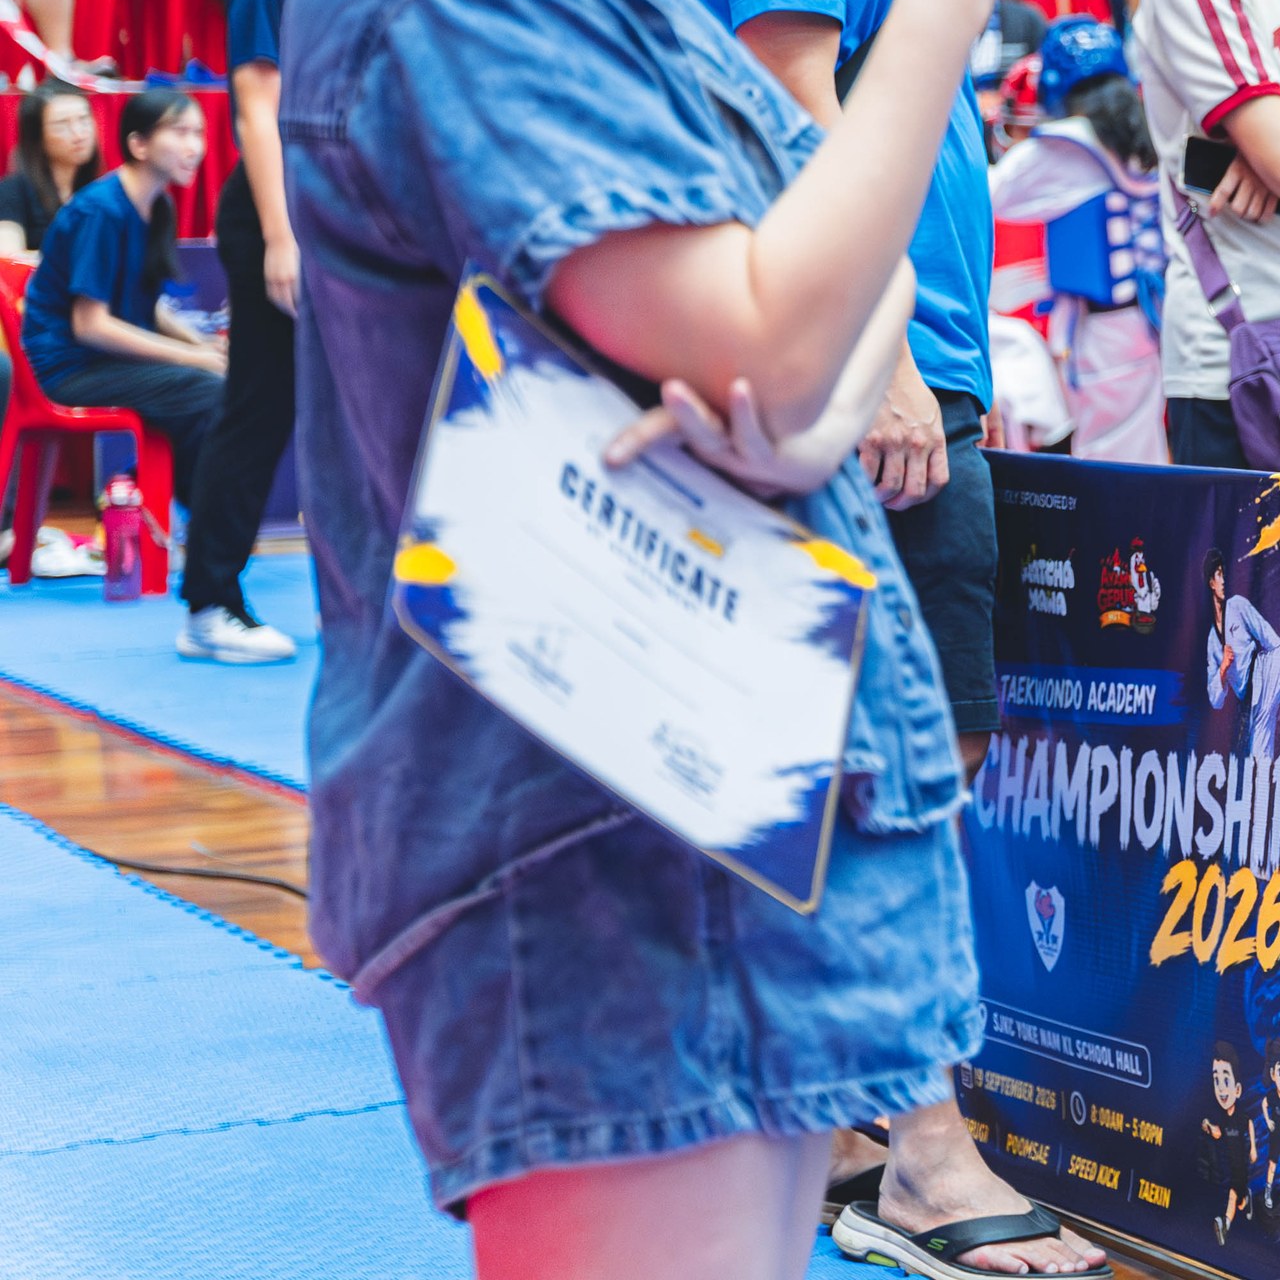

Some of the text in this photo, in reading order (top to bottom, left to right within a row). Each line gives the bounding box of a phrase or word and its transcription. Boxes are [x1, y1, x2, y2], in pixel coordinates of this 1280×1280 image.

[559, 462, 739, 624] CERTIFICATE
[1001, 674, 1156, 715] TAEKWONDO ACADEMY
[1076, 1040, 1114, 1068] SCHOOL
[1116, 1051, 1142, 1076] HALL
[984, 1070, 1034, 1102] SEPTEMBER
[1090, 1104, 1124, 1133] 8:00AM
[1132, 1117, 1163, 1147] 5:00PM
[1006, 1133, 1050, 1165] POOMSAE
[1068, 1154, 1098, 1182] SPEED
[1097, 1164, 1121, 1190] KICK
